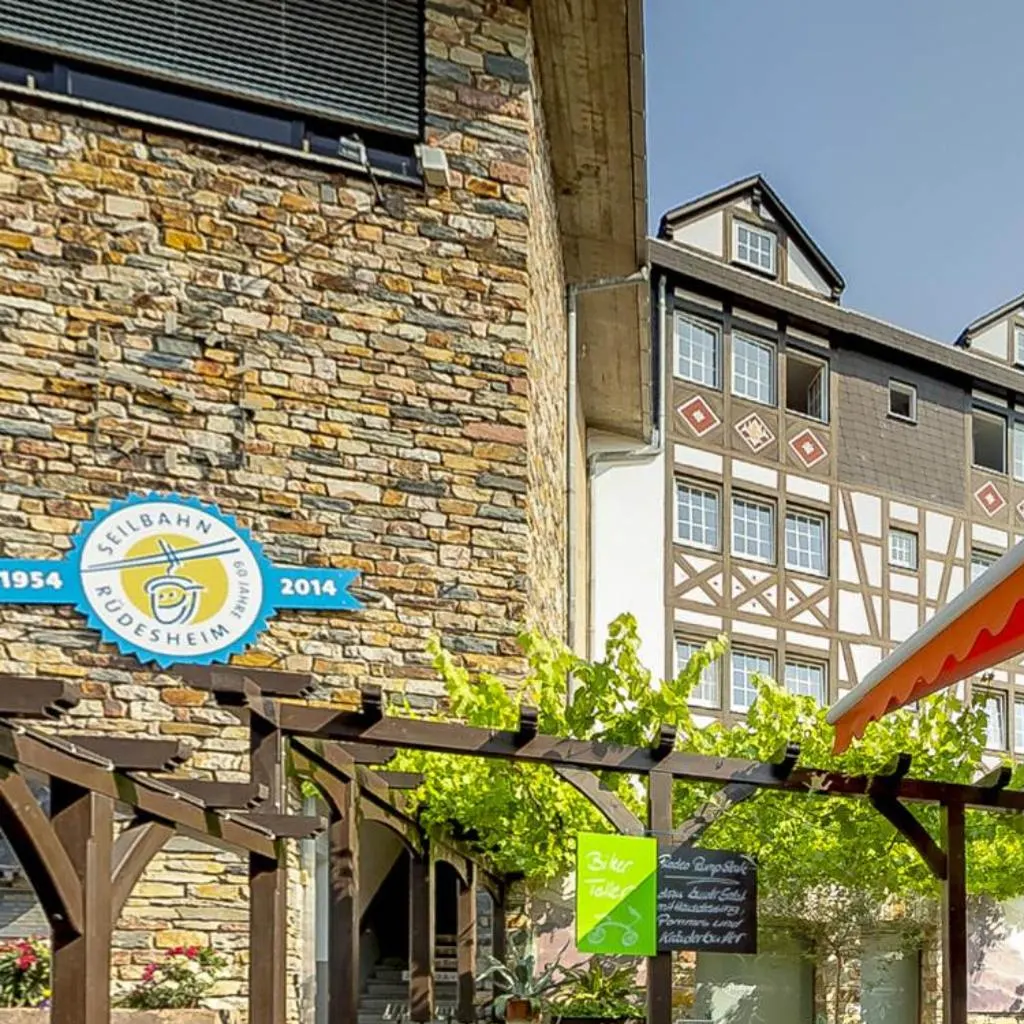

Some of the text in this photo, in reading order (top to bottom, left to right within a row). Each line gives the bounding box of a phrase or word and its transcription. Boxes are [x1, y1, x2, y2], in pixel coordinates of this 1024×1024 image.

[98, 512, 212, 555] SEILBAHN
[233, 560, 248, 578] 60
[0, 570, 64, 589] 1954
[280, 577, 338, 596] 2014
[95, 585, 230, 646] RÜDESHEIM
[585, 851, 634, 873] Biker
